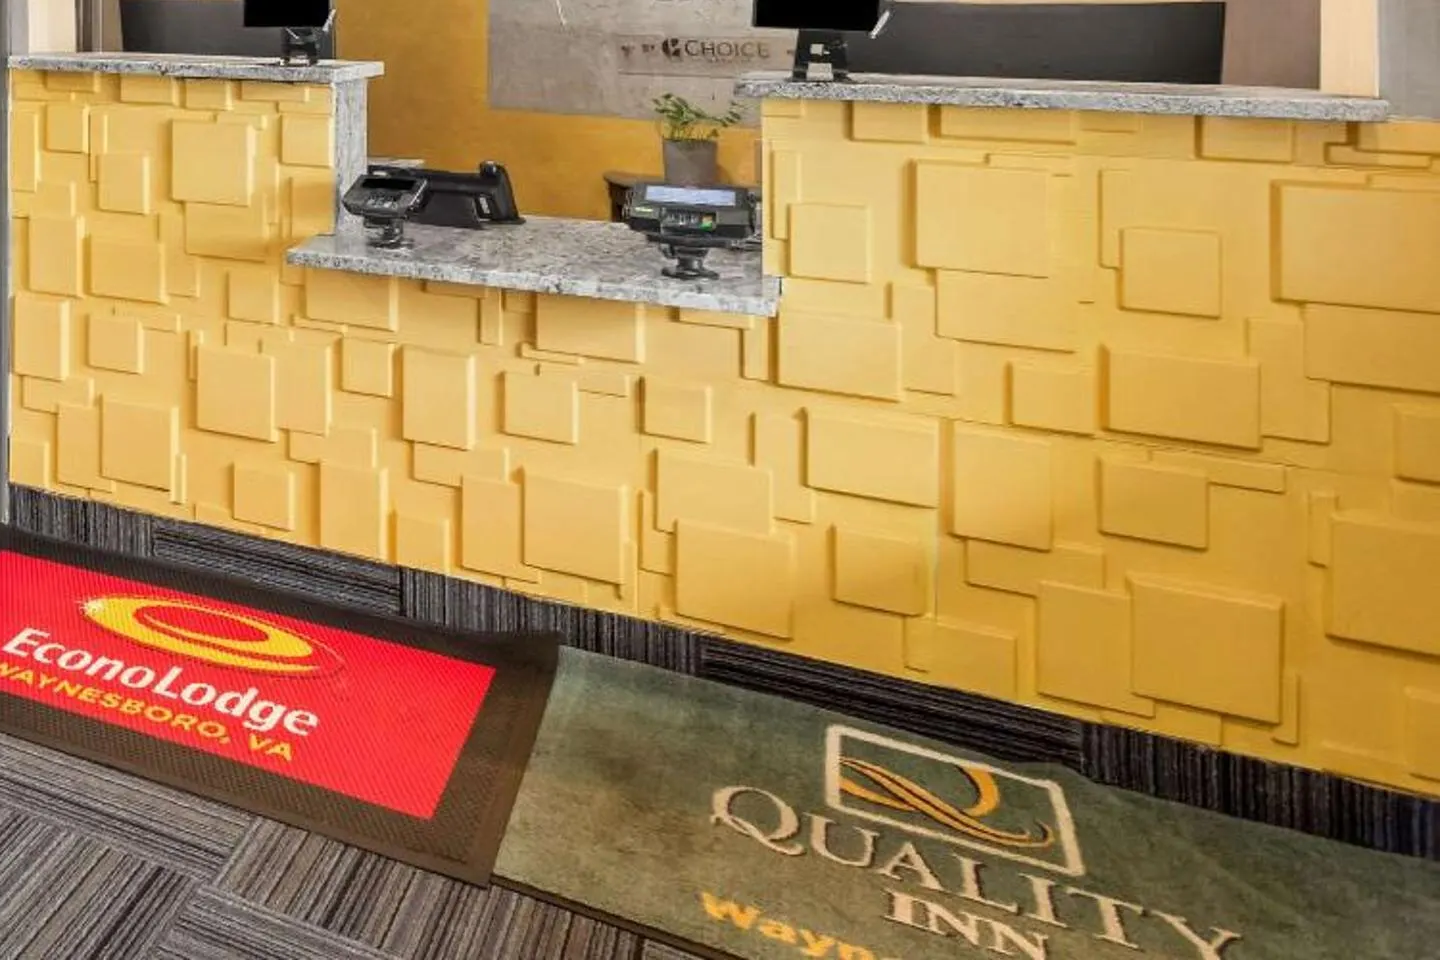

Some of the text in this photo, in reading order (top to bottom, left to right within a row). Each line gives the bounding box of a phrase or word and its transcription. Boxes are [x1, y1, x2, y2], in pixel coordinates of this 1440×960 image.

[685, 39, 770, 59] CHOICE
[1, 627, 319, 736] EconoLodge
[248, 733, 293, 762] VA
[710, 785, 1243, 960] QUALITY
[700, 891, 902, 960] Wayn
[881, 887, 1050, 960] INN
